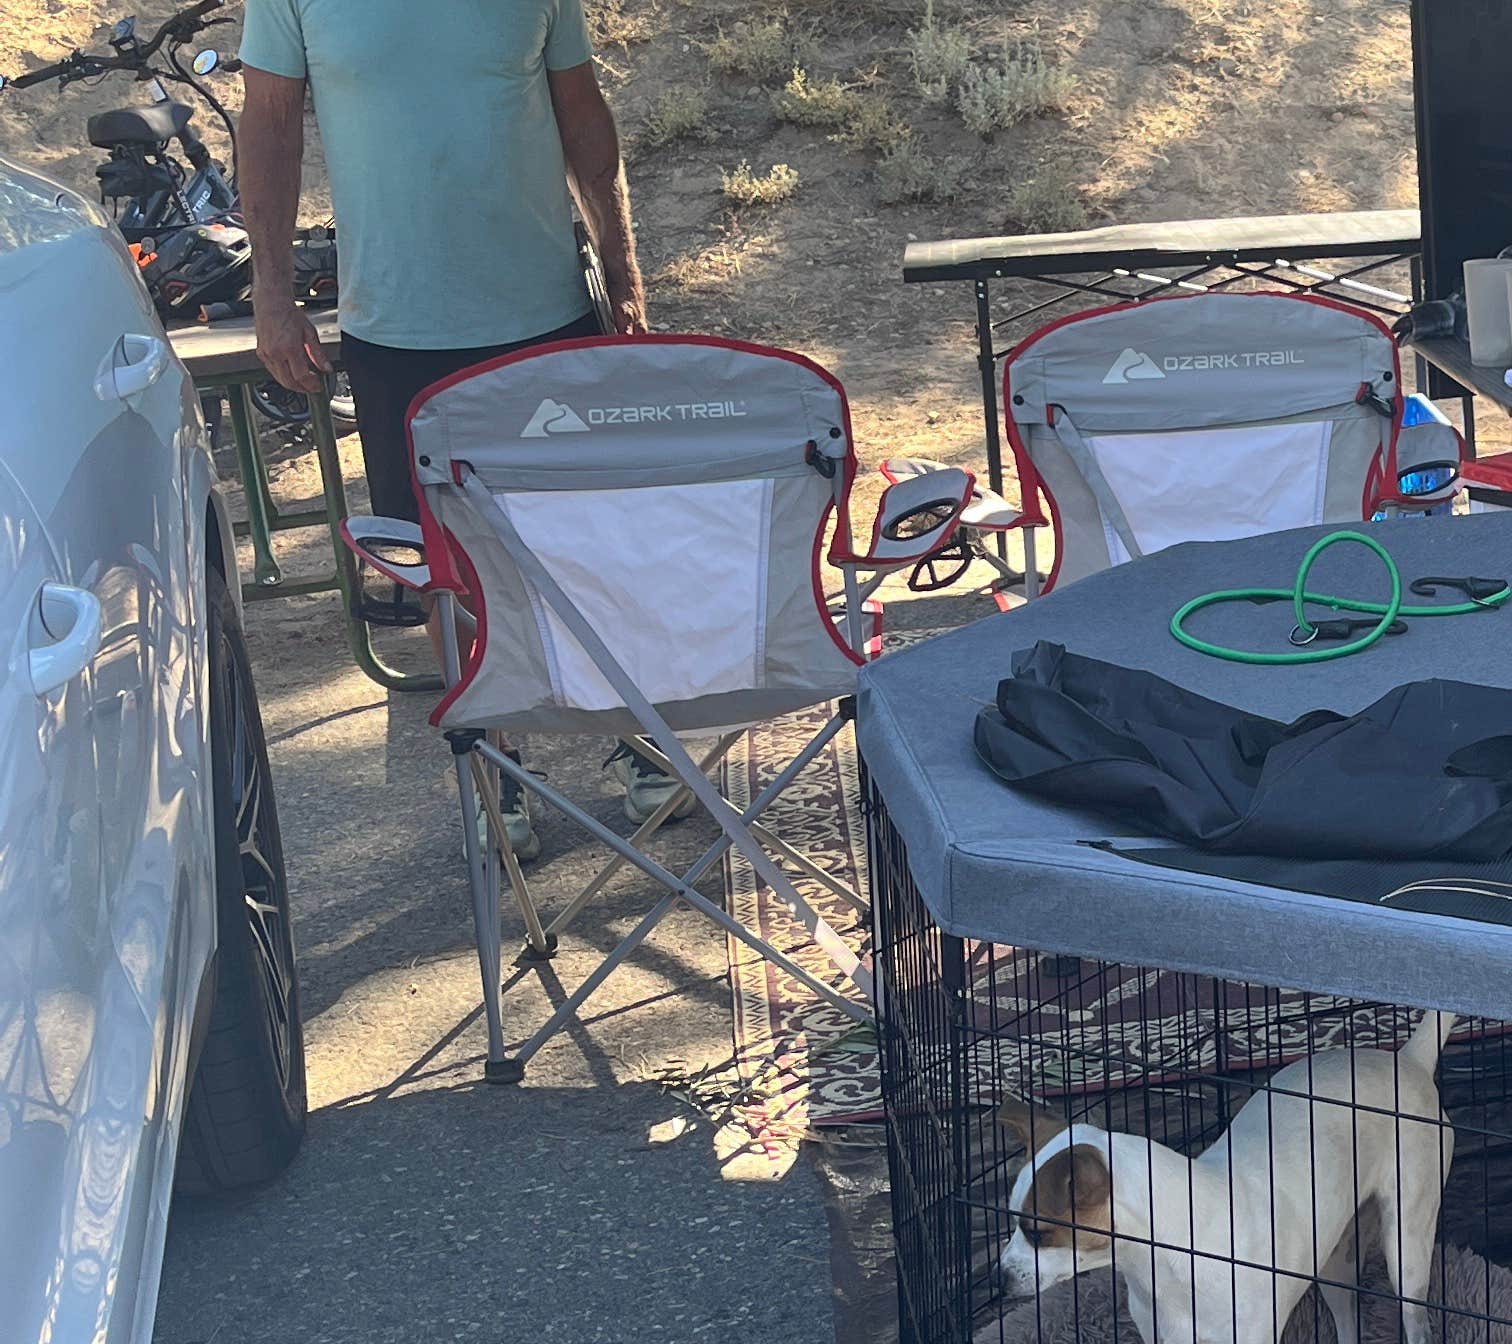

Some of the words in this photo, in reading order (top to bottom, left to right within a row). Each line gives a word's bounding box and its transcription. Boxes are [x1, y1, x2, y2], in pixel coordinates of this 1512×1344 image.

[176, 189, 197, 224] LECTRI
[191, 190, 212, 214] TRIC
[1164, 353, 1239, 371] OZARK
[588, 405, 673, 425] OZARK
